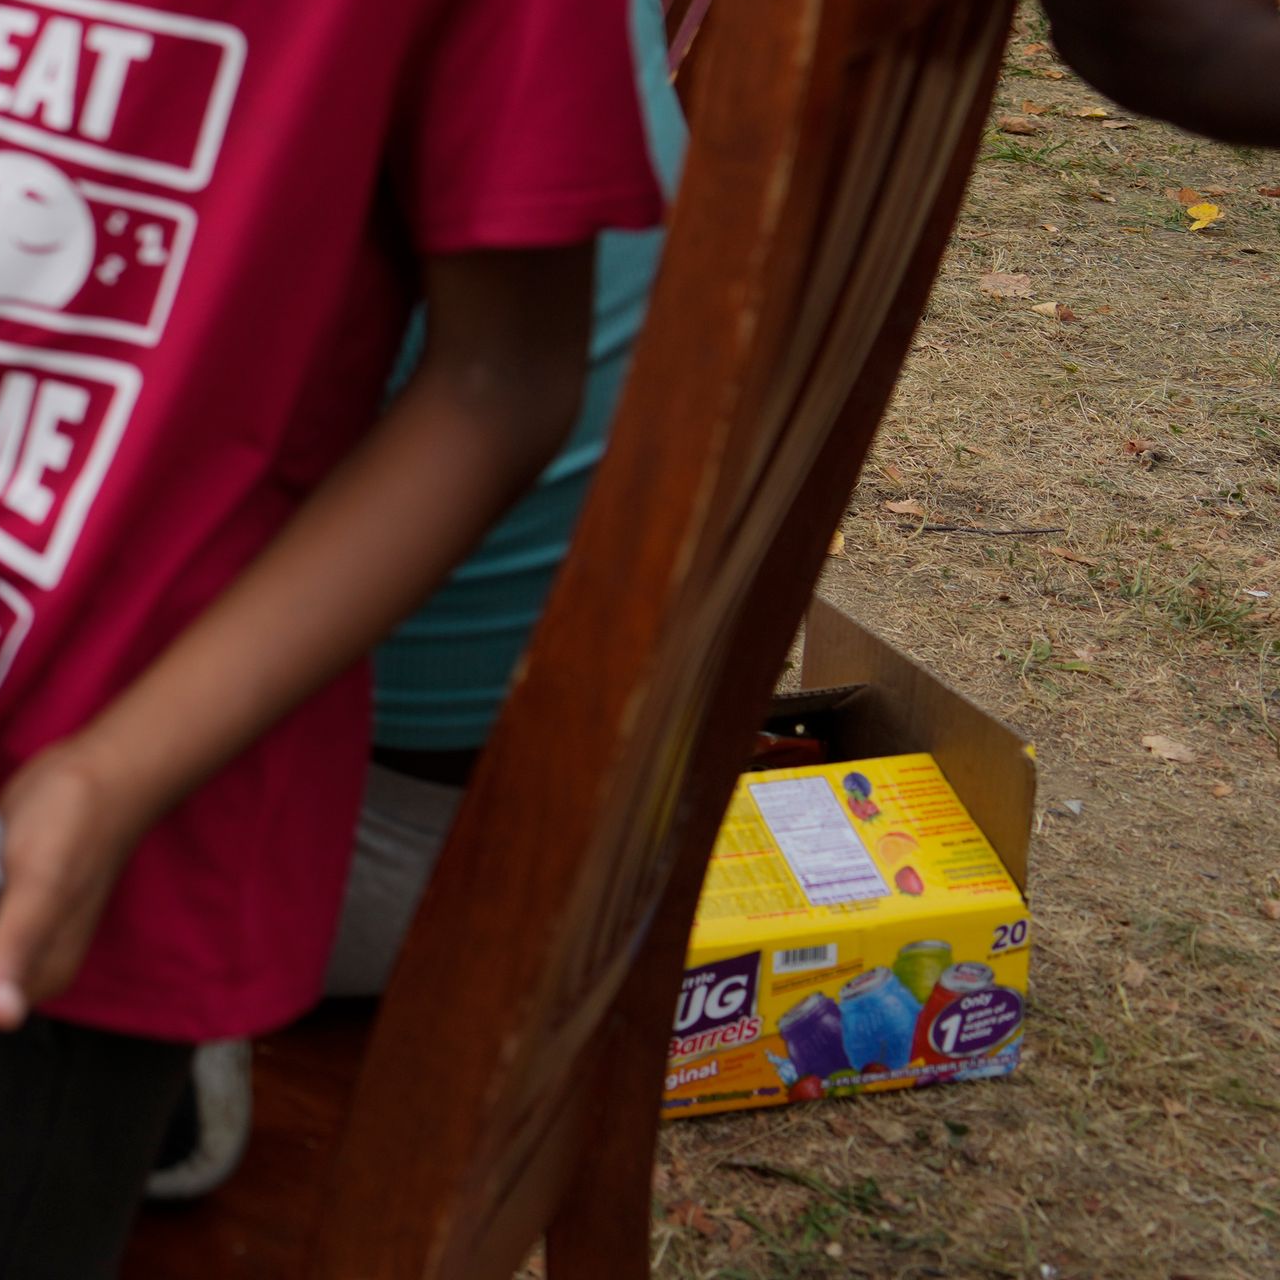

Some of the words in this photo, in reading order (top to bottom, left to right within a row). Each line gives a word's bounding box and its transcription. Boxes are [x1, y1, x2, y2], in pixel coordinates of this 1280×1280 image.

[992, 920, 1027, 951] 20
[682, 972, 716, 989] ittle
[673, 974, 749, 1031] UG
[940, 1014, 961, 1052] 1
[666, 1060, 718, 1090] ginal
